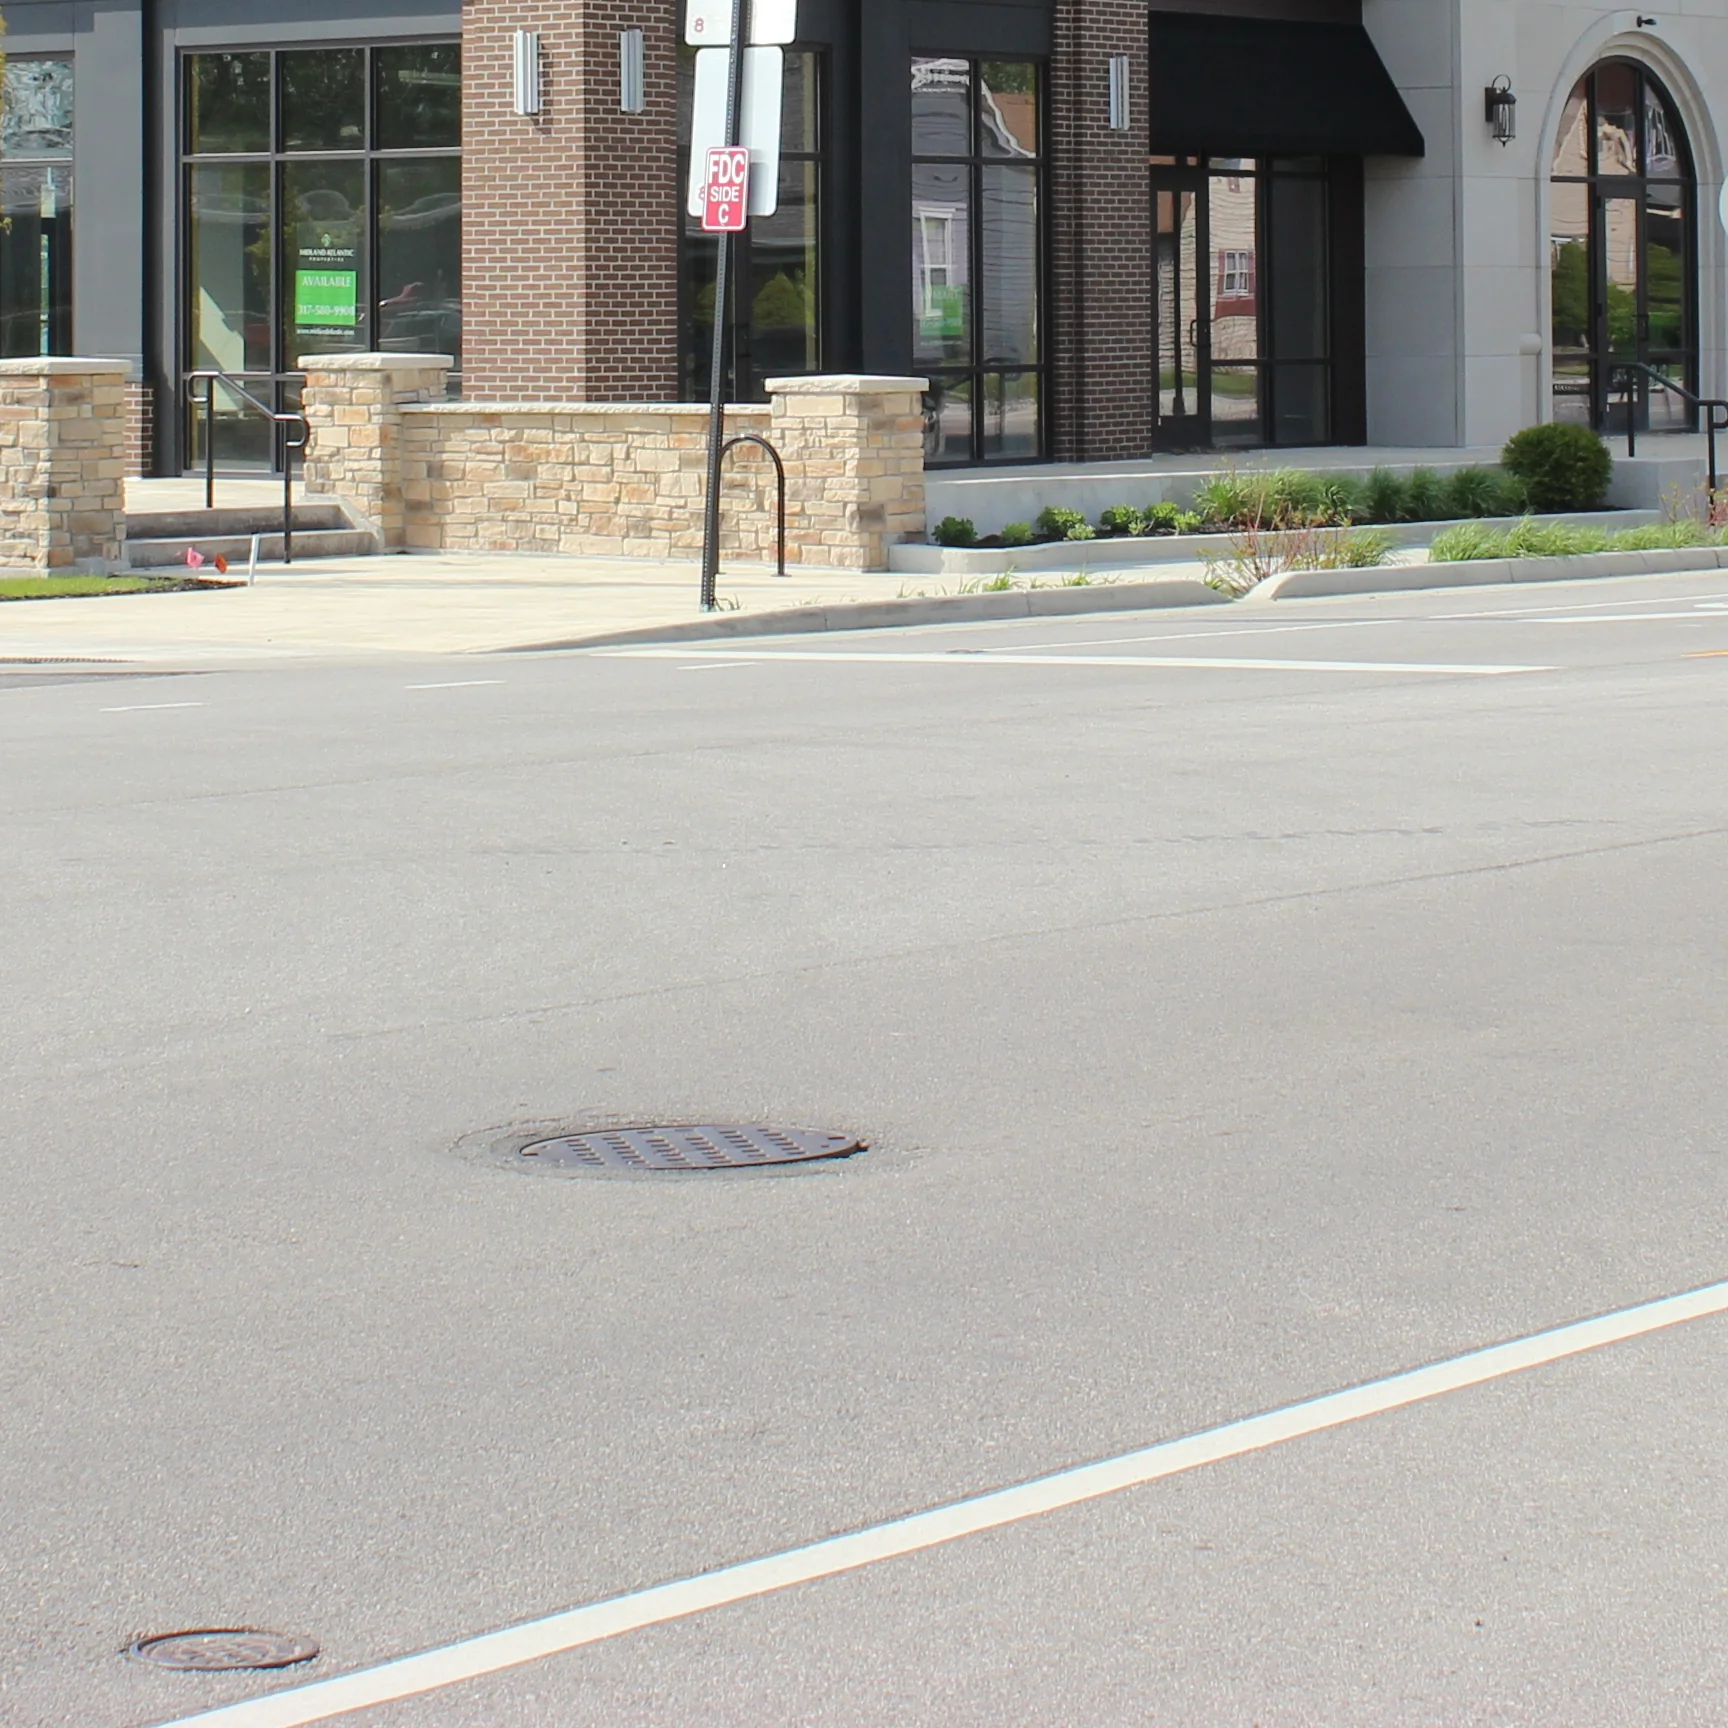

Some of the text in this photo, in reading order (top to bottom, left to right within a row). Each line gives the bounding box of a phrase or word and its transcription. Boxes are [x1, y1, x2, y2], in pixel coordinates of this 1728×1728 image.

[708, 154, 745, 185] FDC
[710, 186, 740, 202] SIDE
[717, 204, 729, 224] C
[302, 276, 351, 287] AVAILABLE
